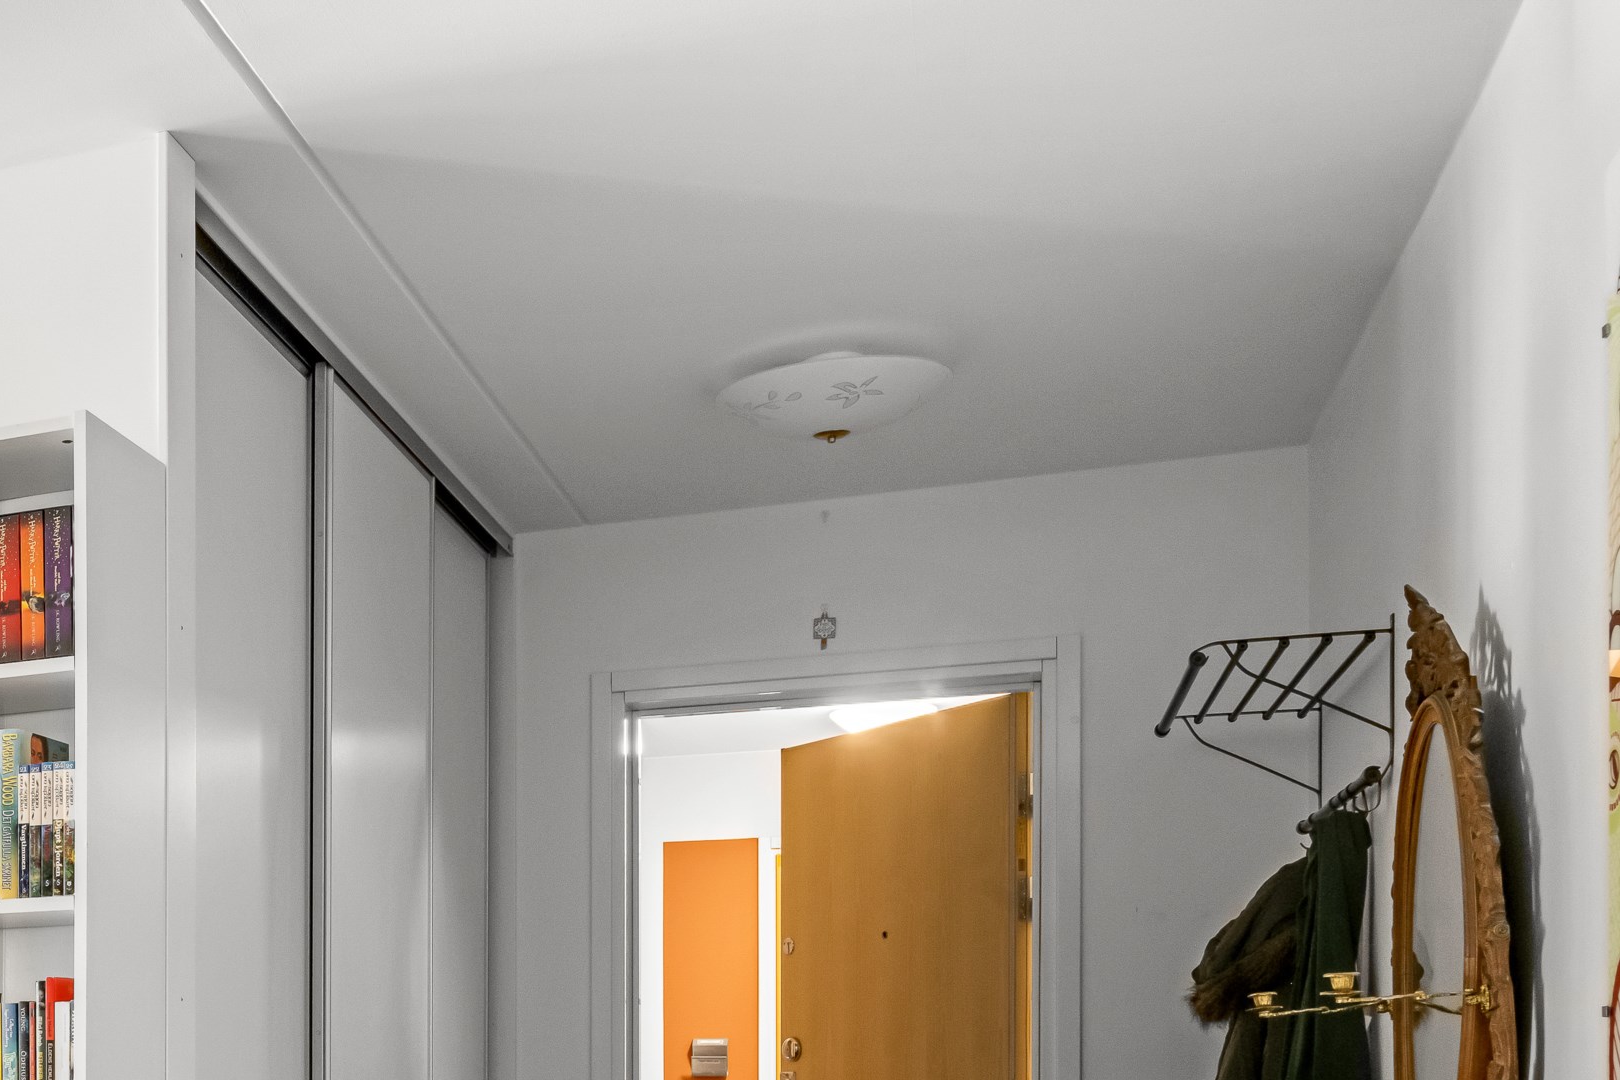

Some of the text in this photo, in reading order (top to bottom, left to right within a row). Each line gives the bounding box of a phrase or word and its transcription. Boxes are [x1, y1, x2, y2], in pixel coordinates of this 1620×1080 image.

[53, 515, 61, 538] HARRY
[53, 538, 62, 561] POTTER
[1, 733, 17, 774] BARBARA
[1, 776, 17, 805] WOOD
